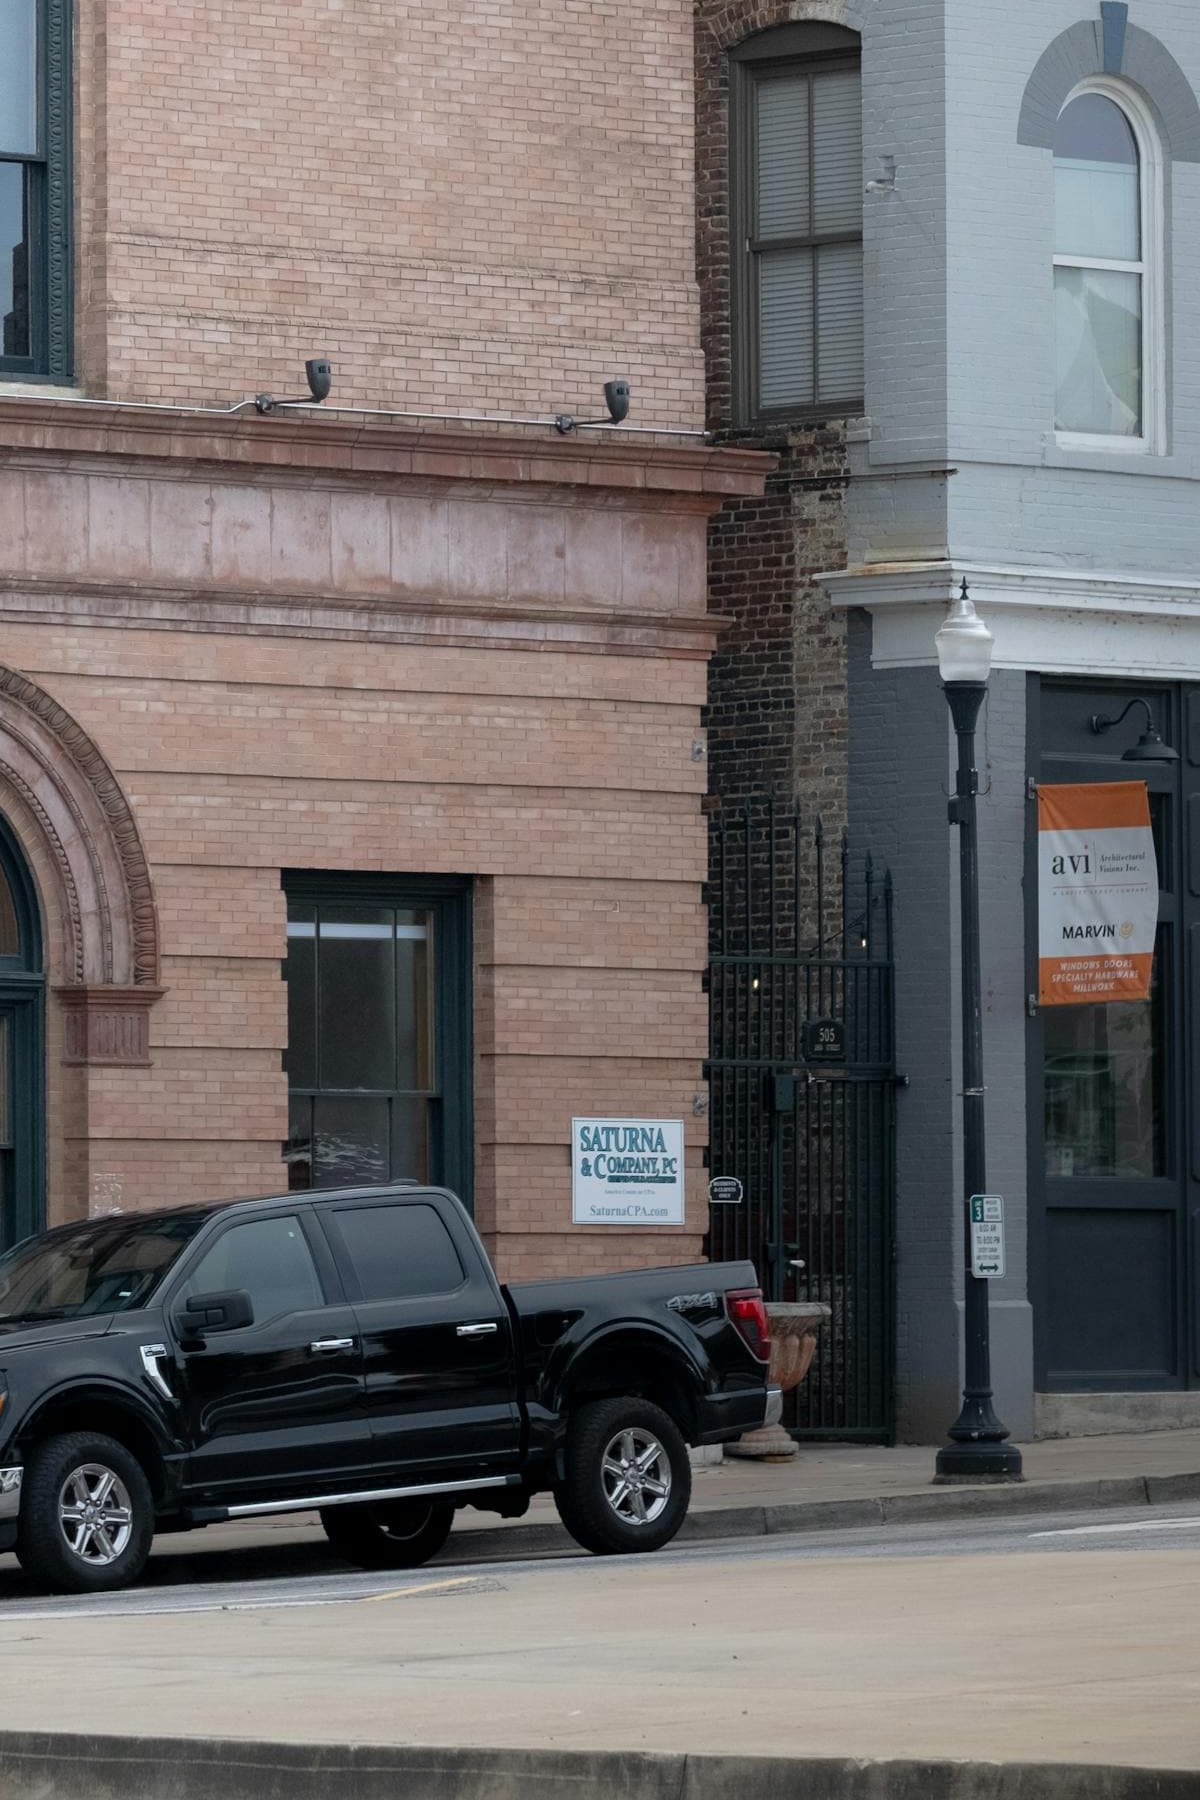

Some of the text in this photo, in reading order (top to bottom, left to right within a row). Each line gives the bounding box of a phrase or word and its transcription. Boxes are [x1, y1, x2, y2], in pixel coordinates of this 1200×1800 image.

[1052, 844, 1091, 875] avi
[1101, 851, 1146, 862] Architectural
[1100, 864, 1140, 873] Visions Inc.
[1062, 924, 1115, 939] MARVIN
[1060, 960, 1132, 971] WINDOWS DOORS
[1051, 970, 1138, 983] SPECIALTY HARDWARE
[1073, 982, 1115, 992] MILLWORK
[820, 1028, 835, 1042] 505
[580, 1126, 667, 1152] SATURNA
[581, 1157, 592, 1176] &
[594, 1154, 660, 1179] COMPANY,
[662, 1157, 677, 1174] PC
[590, 1205, 668, 1217] SaturnaCPA.com
[975, 1206, 982, 1220] 3
